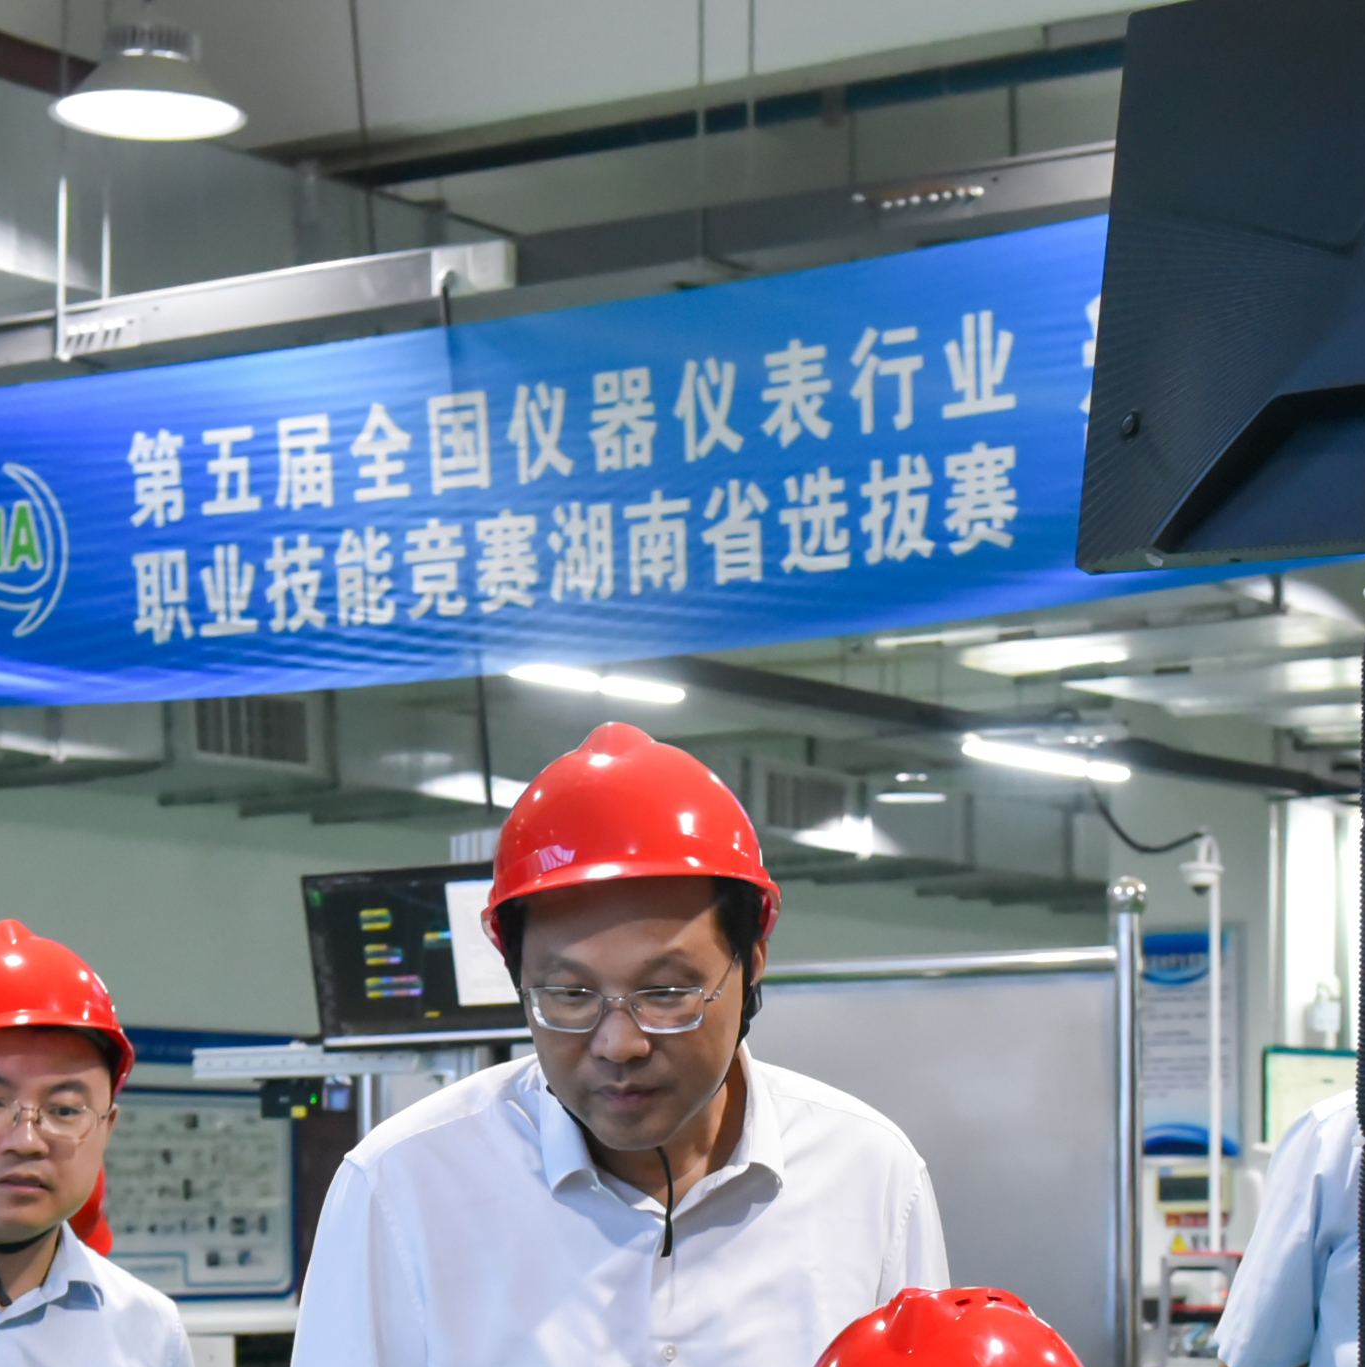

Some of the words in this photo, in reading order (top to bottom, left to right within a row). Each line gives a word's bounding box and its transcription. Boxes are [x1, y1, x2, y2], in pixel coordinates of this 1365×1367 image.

[126, 309, 1017, 528] 第五届全国仪器仪表行业
[131, 442, 1018, 644] 职业技能竞赛湖南省选拔赛
